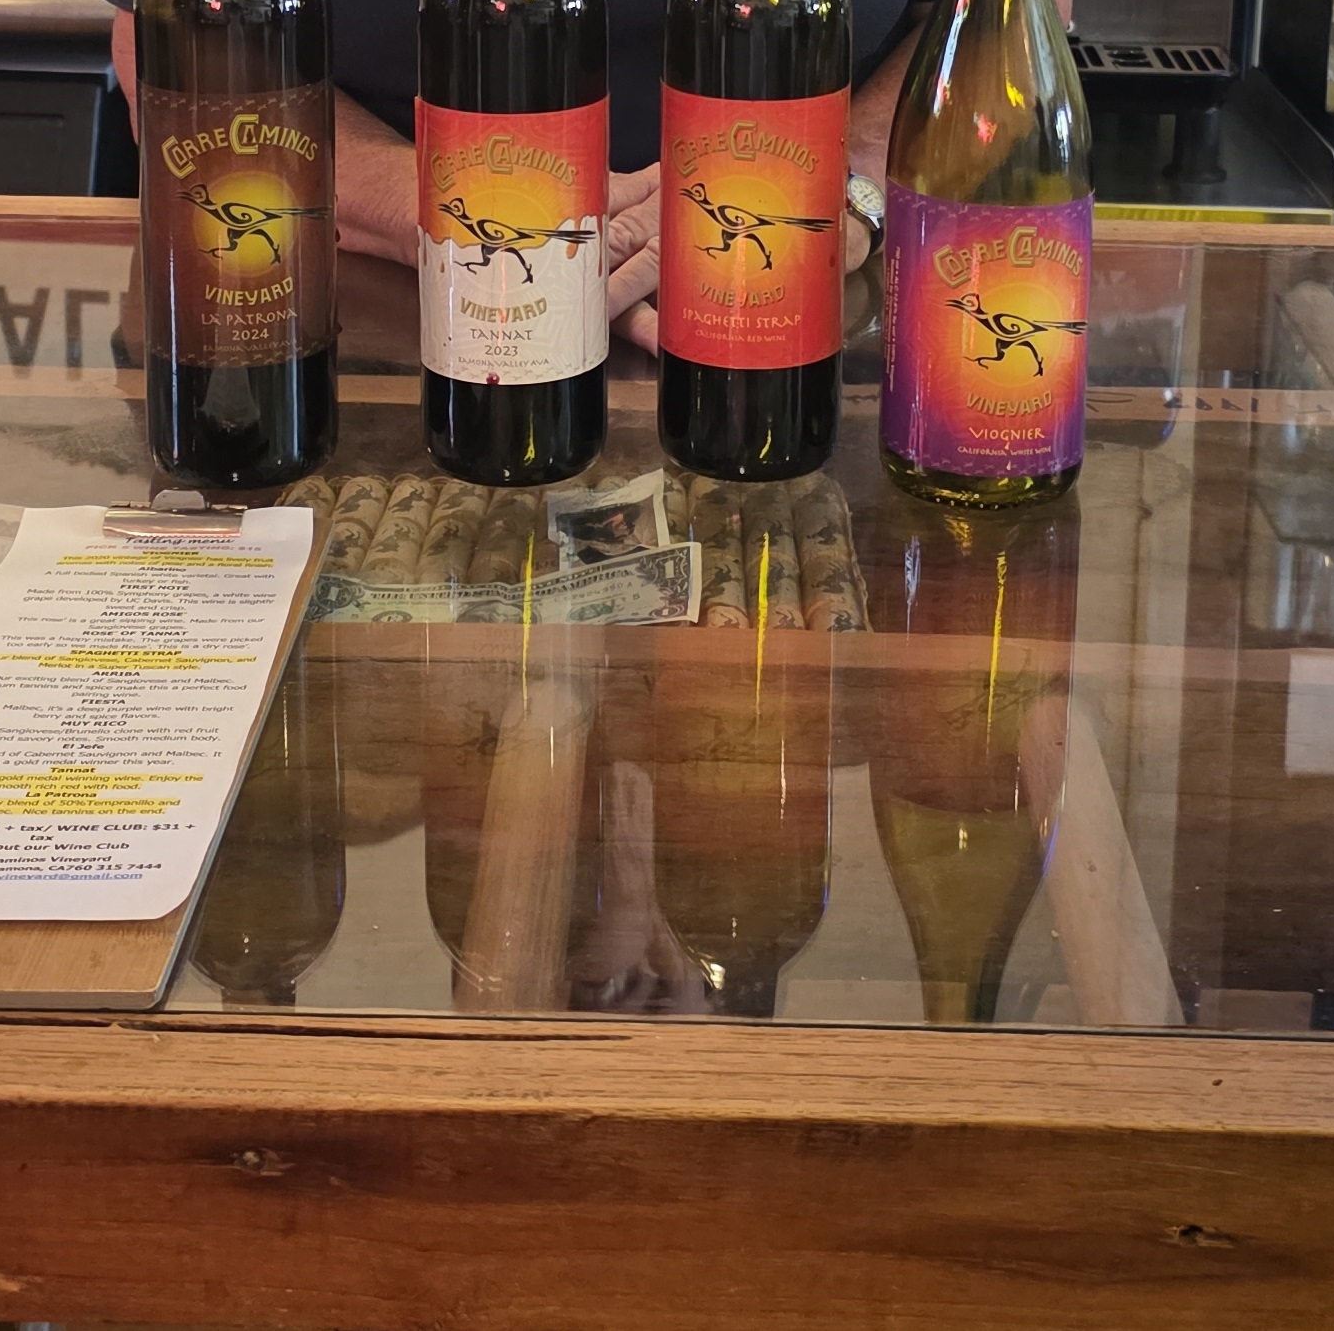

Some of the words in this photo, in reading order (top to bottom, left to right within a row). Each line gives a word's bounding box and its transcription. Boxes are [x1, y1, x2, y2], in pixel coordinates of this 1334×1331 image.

[161, 113, 319, 180] CORRECAMINOS
[671, 120, 820, 179] CORRECAMINOS
[430, 134, 579, 193] CORRECAMINOS
[932, 226, 1084, 288] CORRECAMINOS
[204, 276, 295, 307] VINEYARD
[698, 281, 787, 309] VINEYARD
[201, 313, 222, 326] LA
[226, 307, 297, 326] PATRONA
[460, 296, 548, 324] VINEYARD
[682, 307, 750, 329] SPAGHETTI
[756, 314, 802, 329] STRAP
[232, 328, 270, 342] 2024
[470, 328, 533, 341] TANNAT
[485, 344, 519, 357] 2023
[966, 390, 1053, 417] VINEYARD
[969, 427, 1046, 441] VIOGNIER
[957, 445, 1008, 457] CALIFORNIA
[49, 766, 97, 774] Tannat
[25, 791, 41, 799] La
[44, 791, 97, 799] Patrona
[20, 823, 52, 833] tax/
[57, 824, 99, 832] WINE
[103, 823, 148, 831] CLUB:
[152, 822, 180, 831] $31
[30, 833, 54, 841] tax
[24, 843, 50, 851] our
[53, 842, 93, 851] Wine
[96, 842, 130, 850] Club
[51, 855, 112, 865] Vineyard
[96, 863, 123, 871] 315
